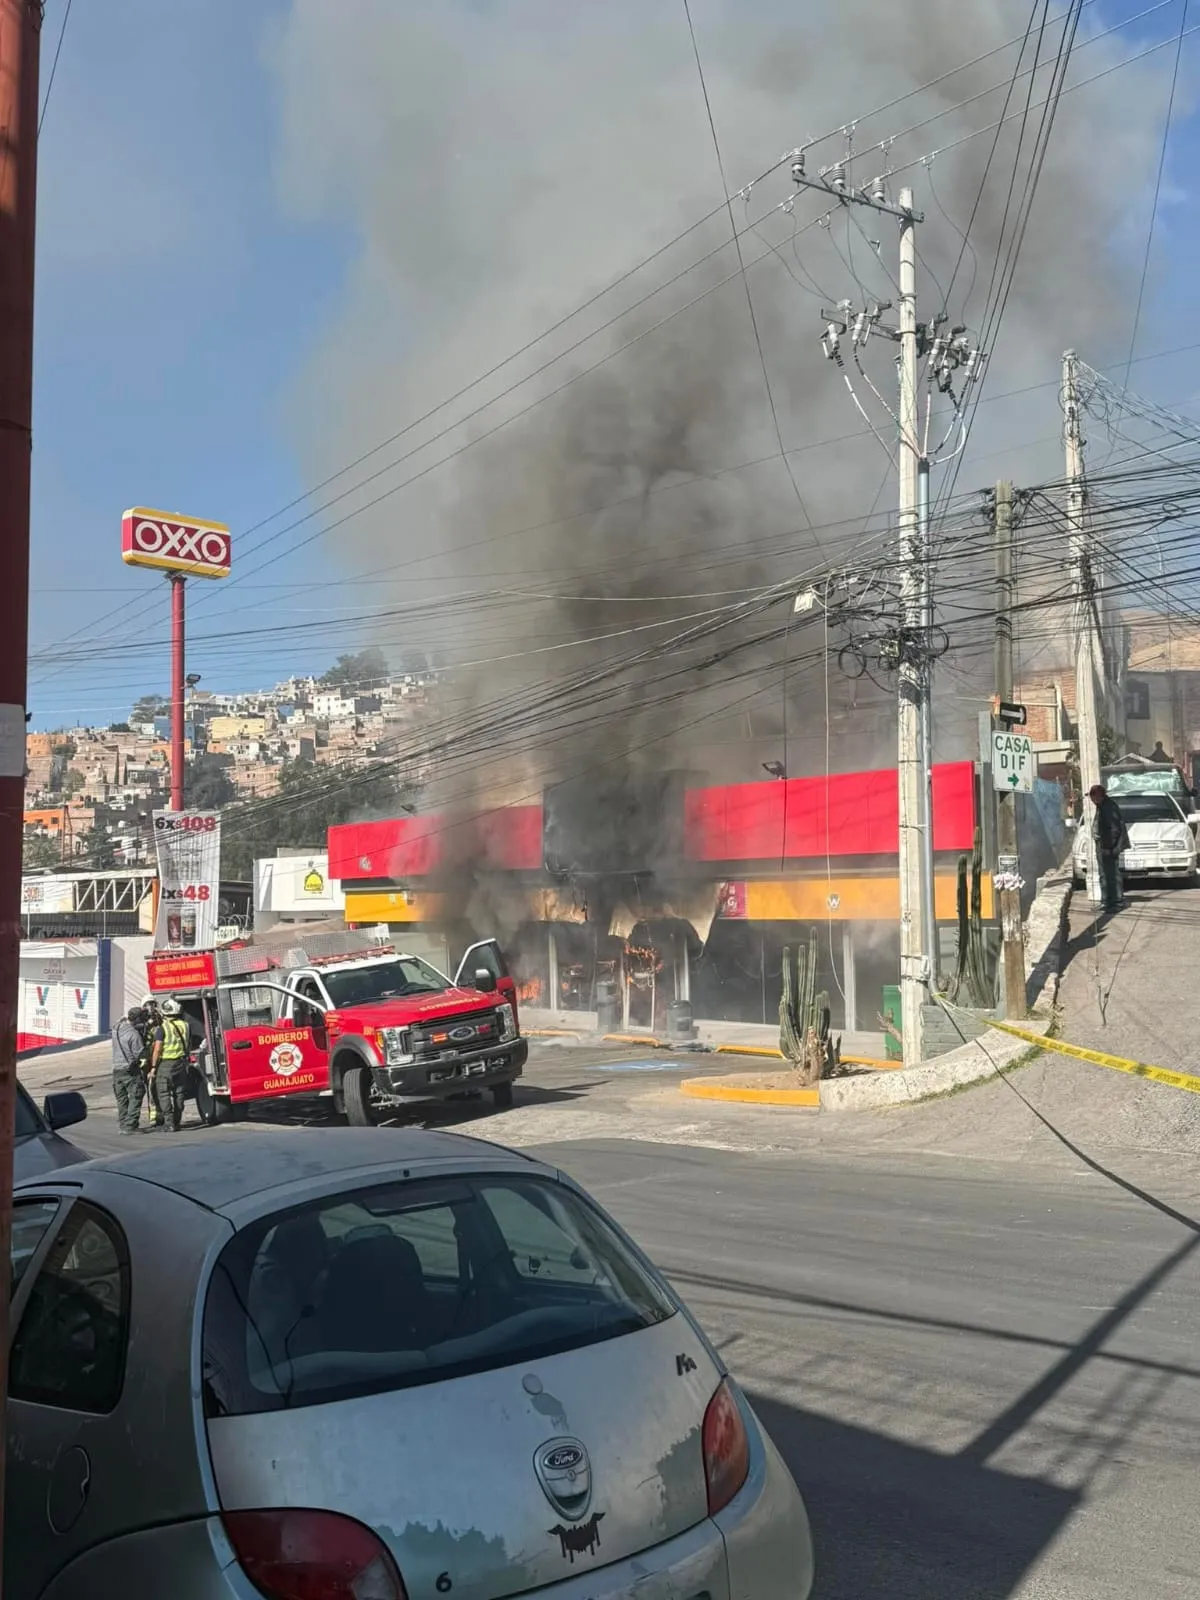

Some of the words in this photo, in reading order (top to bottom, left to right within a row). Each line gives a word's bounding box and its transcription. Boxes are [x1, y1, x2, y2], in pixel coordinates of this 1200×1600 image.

[135, 521, 227, 563] OXXO
[995, 735, 1031, 754] CASA
[1000, 753, 1026, 770] DIF
[258, 1031, 309, 1045] BOMBEROS
[263, 1073, 314, 1090] GUANAJUATO
[554, 1451, 575, 1465] Ford
[436, 1571, 453, 1593] 6
